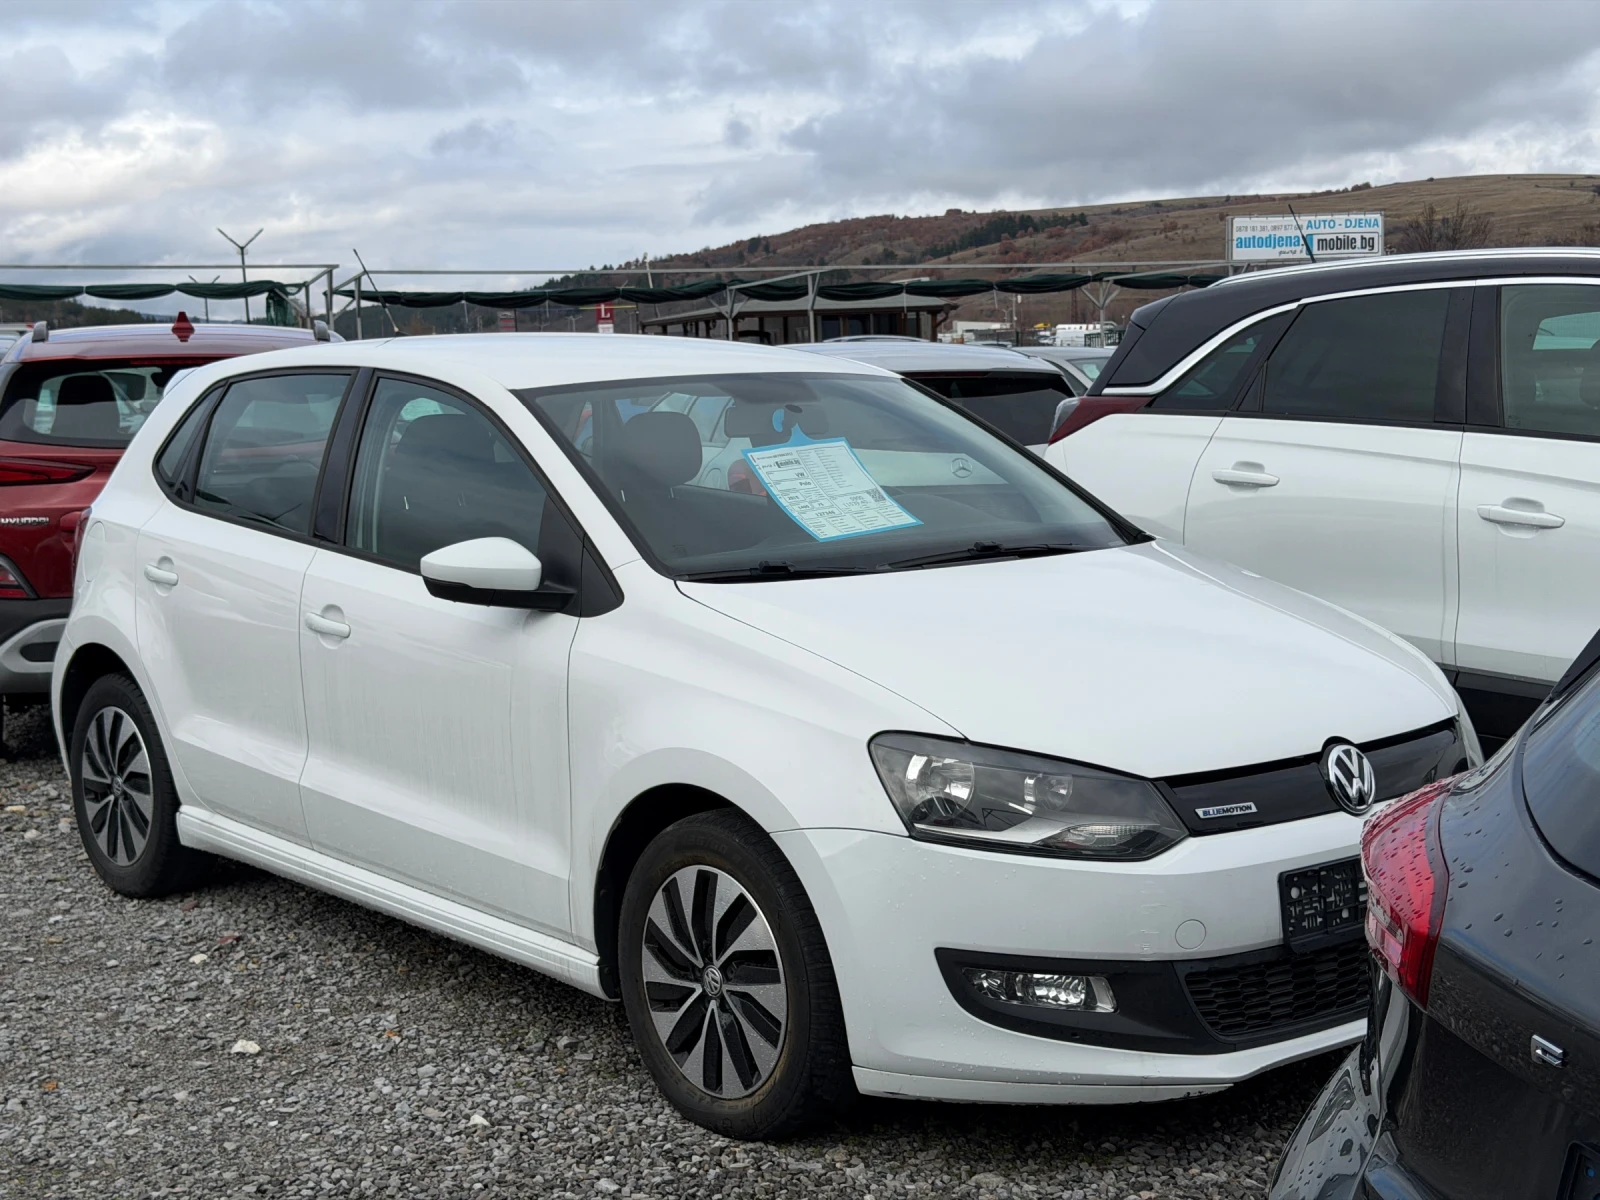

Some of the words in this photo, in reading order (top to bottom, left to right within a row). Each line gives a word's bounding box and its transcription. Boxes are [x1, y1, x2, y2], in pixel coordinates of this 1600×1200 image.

[1306, 219, 1336, 230] AUTO
[1344, 218, 1379, 229] DJENA
[1317, 234, 1375, 251] mobile.bg
[1202, 804, 1253, 817] BLUEMOTION
